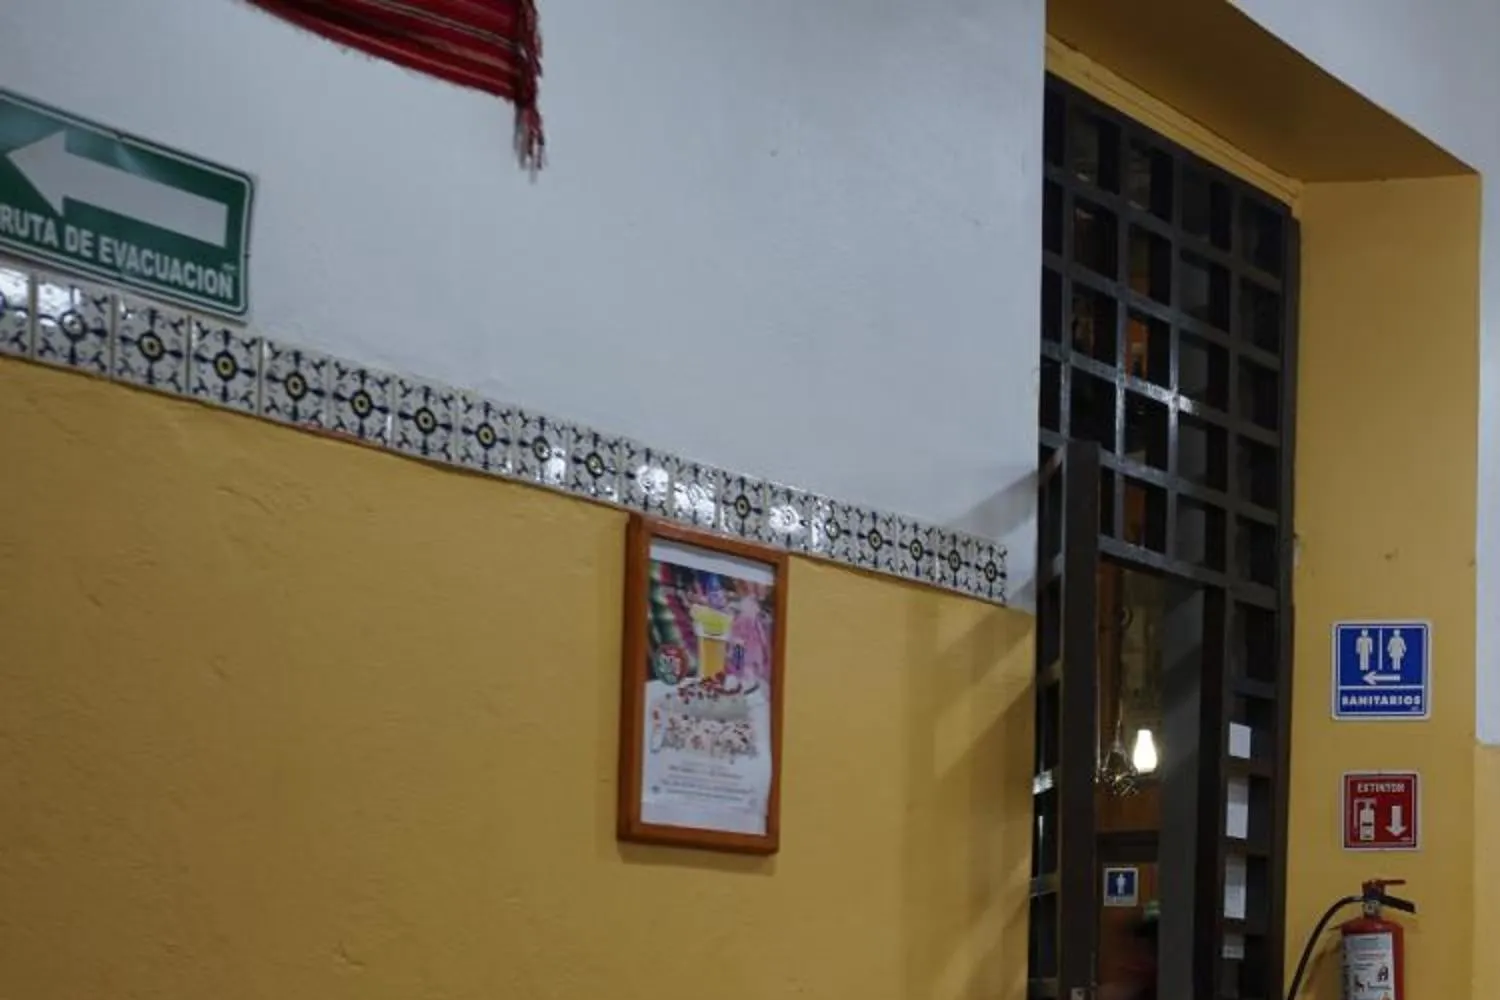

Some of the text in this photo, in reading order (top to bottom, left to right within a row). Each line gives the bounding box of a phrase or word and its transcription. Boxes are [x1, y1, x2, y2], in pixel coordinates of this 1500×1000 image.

[0, 203, 233, 299] RUTA DE EVACUACION
[1341, 695, 1421, 705] SANITARIOS
